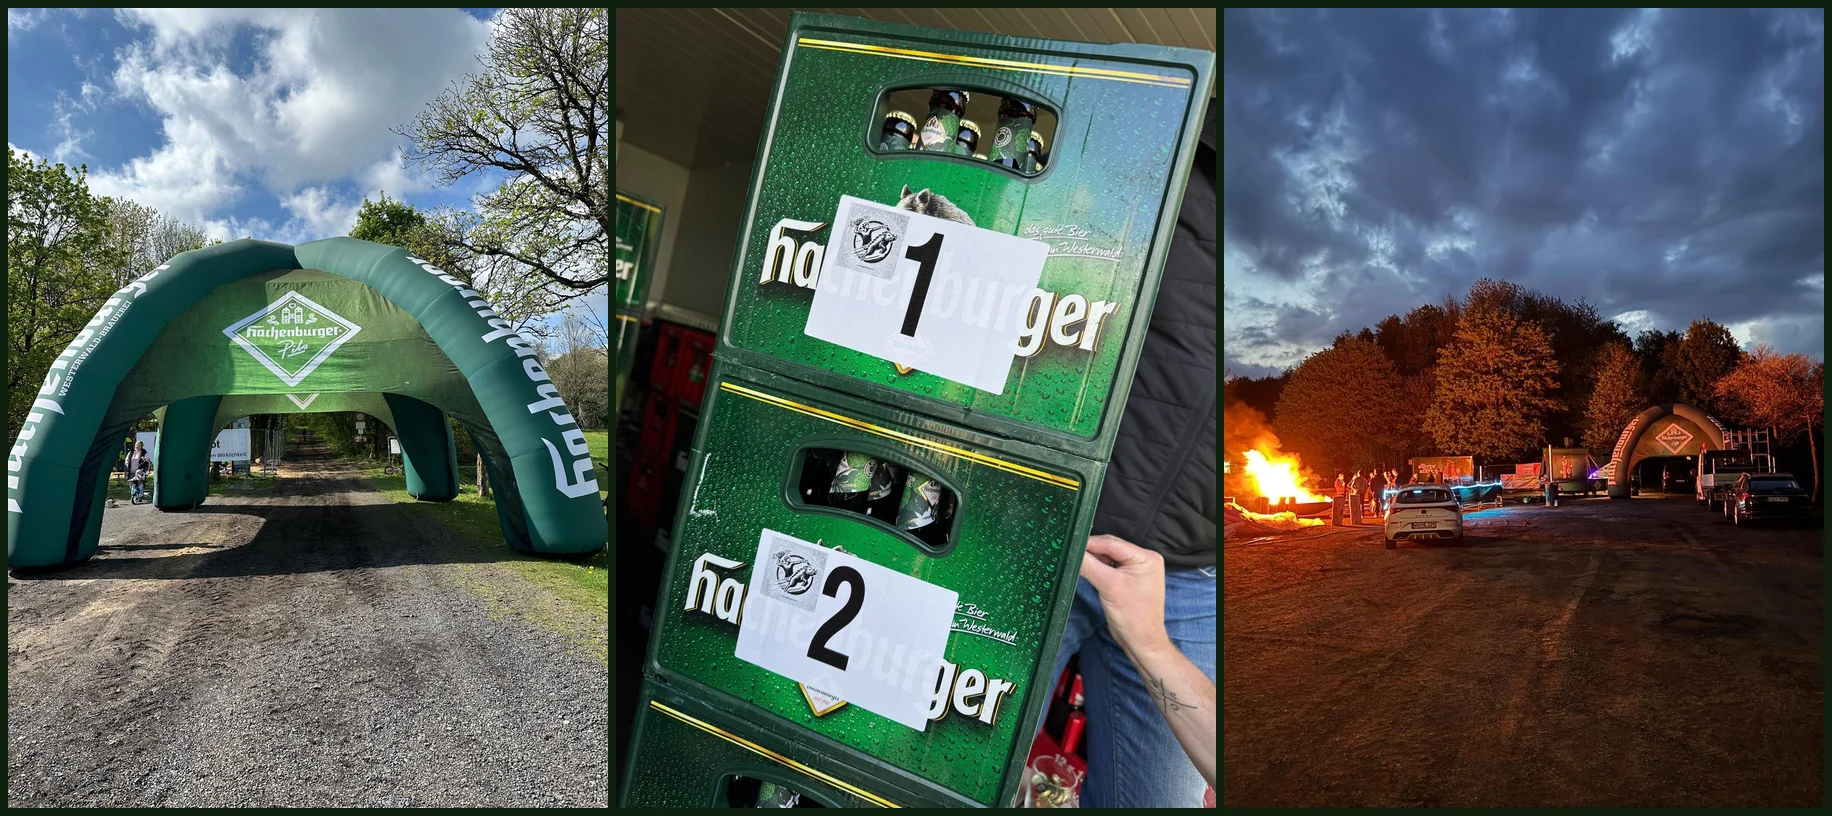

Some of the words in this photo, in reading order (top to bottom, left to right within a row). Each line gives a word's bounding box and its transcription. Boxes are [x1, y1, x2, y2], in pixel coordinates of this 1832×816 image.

[1024, 223, 1040, 235] das
[1039, 223, 1064, 239] gute
[1065, 224, 1091, 237] Bier
[1058, 241, 1122, 258] Westerwald
[900, 232, 944, 338] 1
[59, 300, 132, 397] WESTERWALD-BRAUEREI
[277, 339, 309, 360] Pils
[806, 565, 866, 671] 2
[964, 603, 989, 618] Bier
[959, 619, 1018, 643] Westerwald
